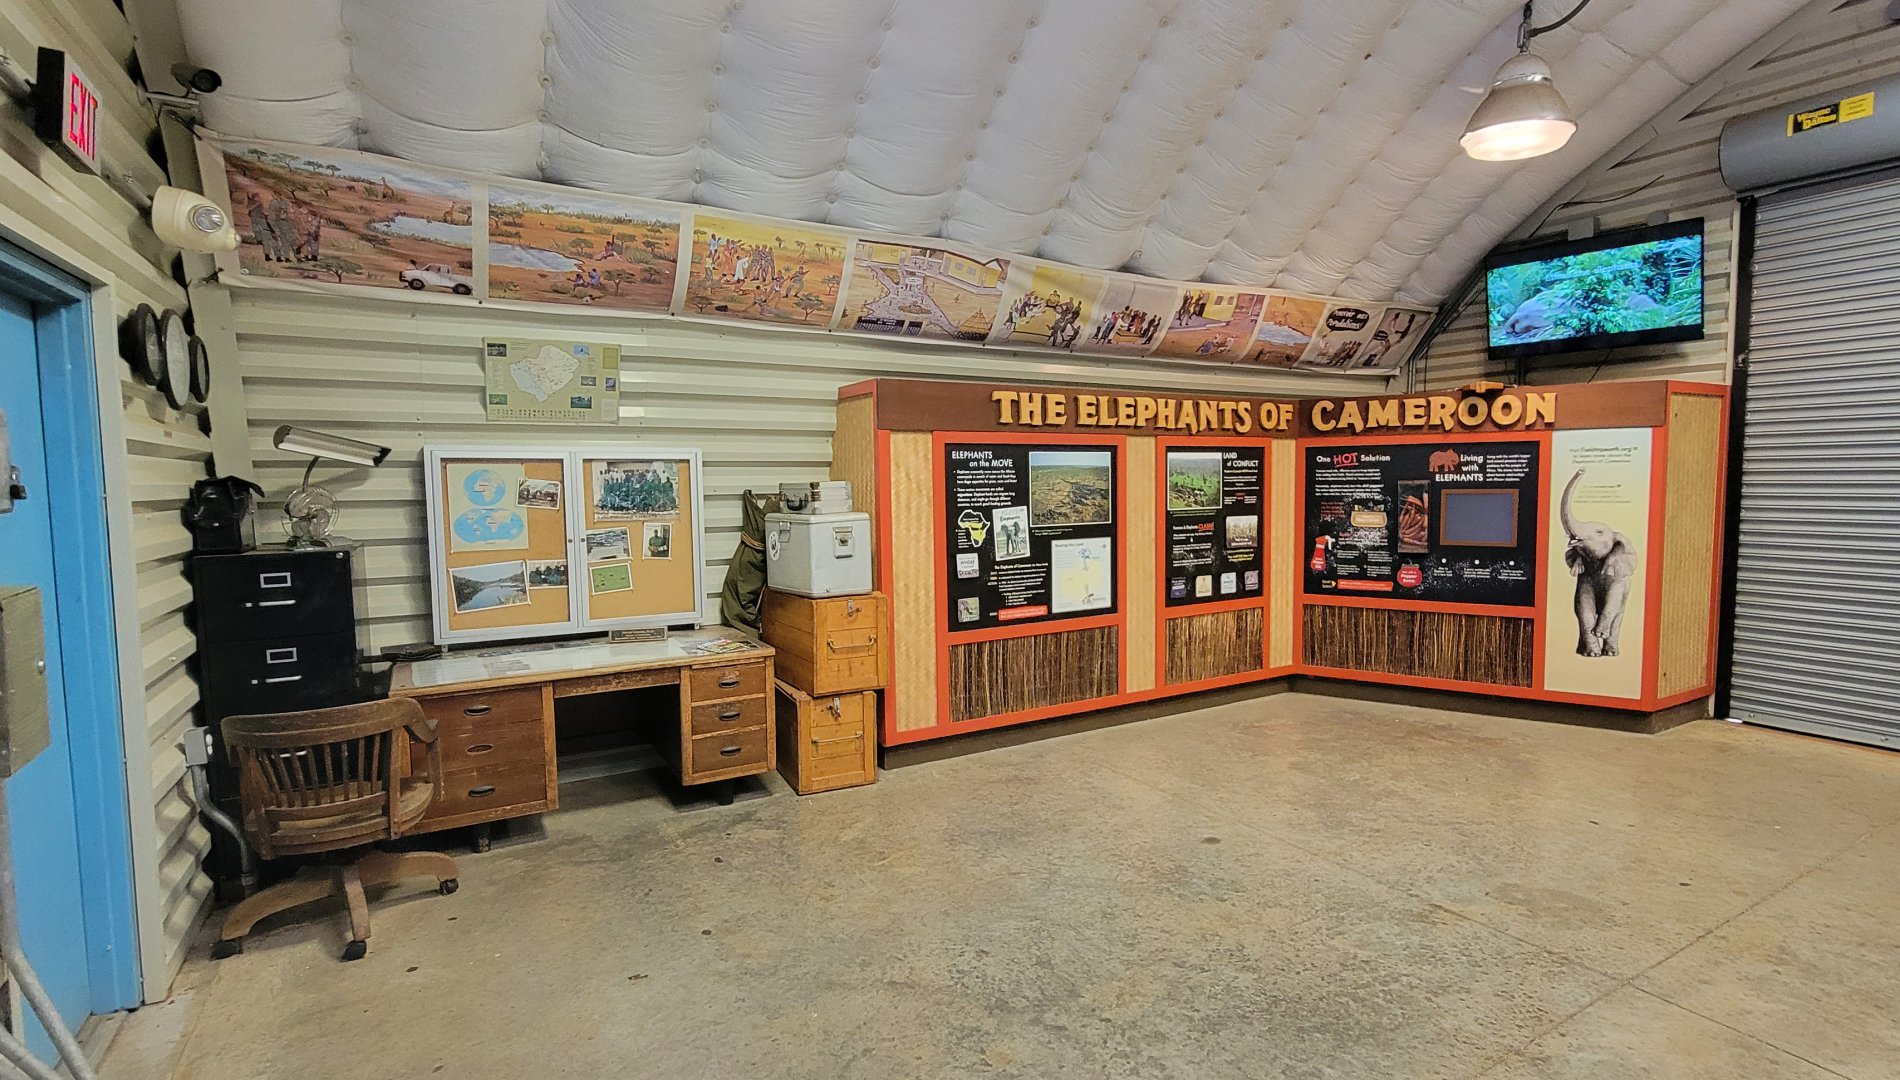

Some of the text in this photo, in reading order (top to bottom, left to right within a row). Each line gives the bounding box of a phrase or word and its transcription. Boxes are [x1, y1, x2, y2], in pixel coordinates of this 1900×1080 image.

[69, 73, 98, 161] EXIT
[991, 390, 1294, 435] THE ELEPHANTS OF
[1311, 392, 1558, 433] CAMEROON
[952, 451, 993, 459] ELEPHANTS
[1316, 453, 1391, 465] One HOT Solution
[1460, 454, 1484, 463] Living
[991, 459, 1013, 467] MOVE
[1461, 463, 1479, 472] with
[1435, 473, 1484, 482] ELEPHANTS
